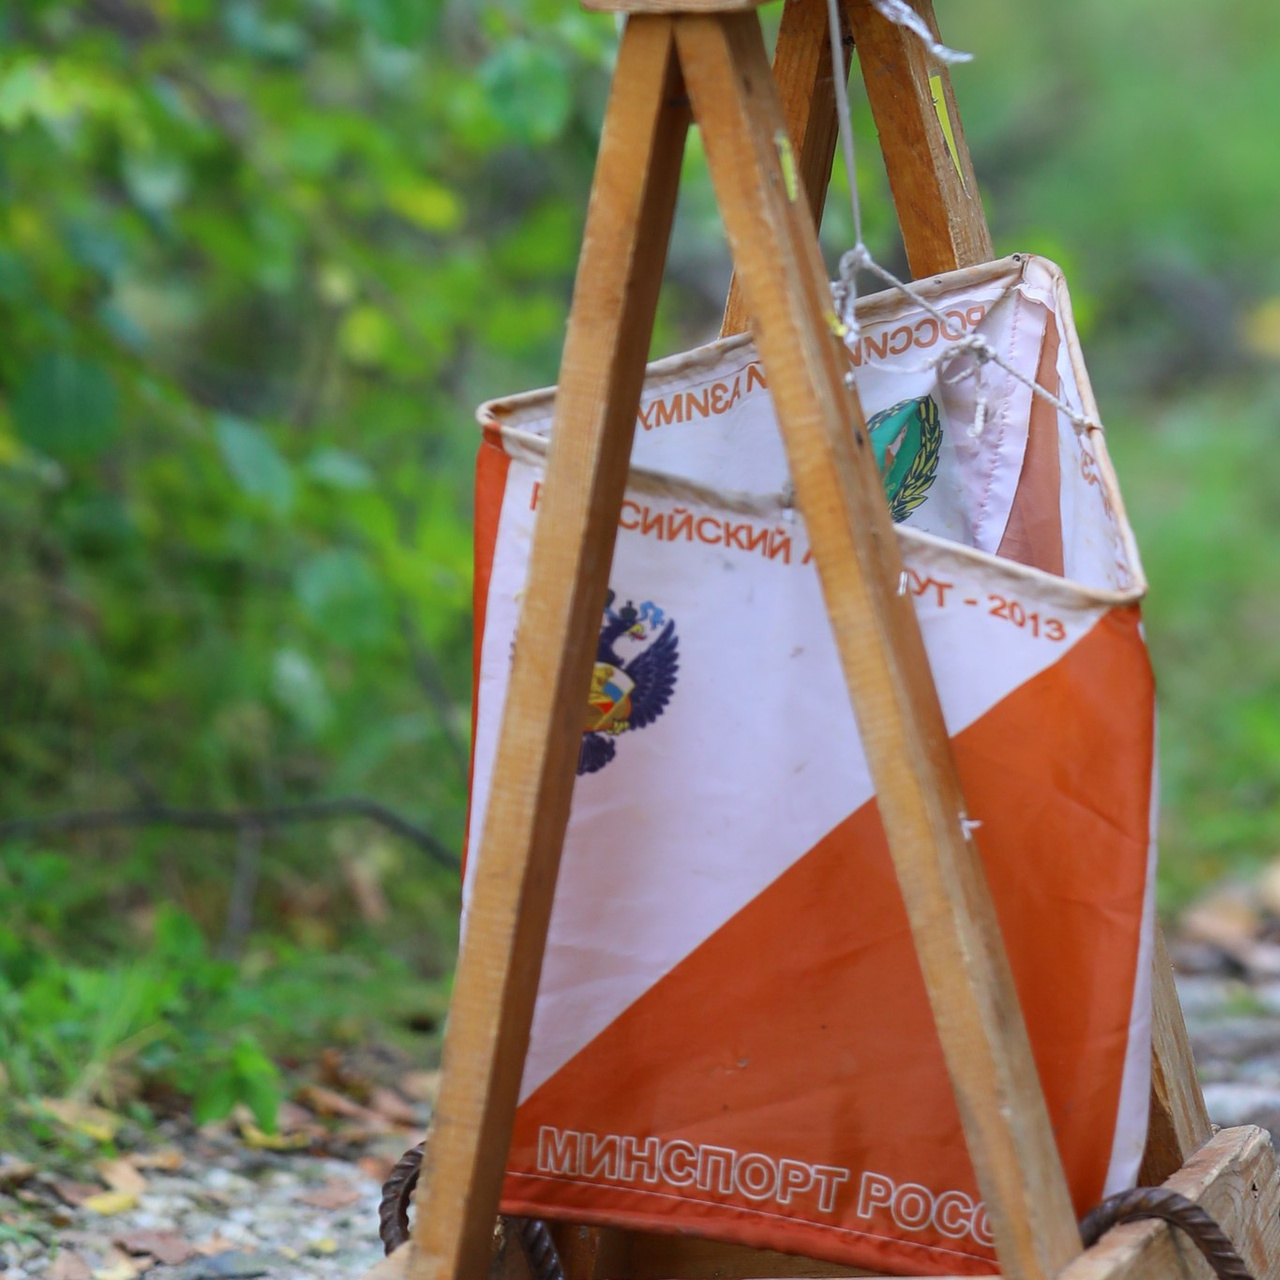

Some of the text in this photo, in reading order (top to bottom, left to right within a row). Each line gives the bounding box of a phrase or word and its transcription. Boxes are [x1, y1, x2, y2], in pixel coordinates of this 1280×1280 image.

[988, 593, 1066, 641] 2013
[537, 1126, 996, 1247] МИНСПОРТ РОСС
